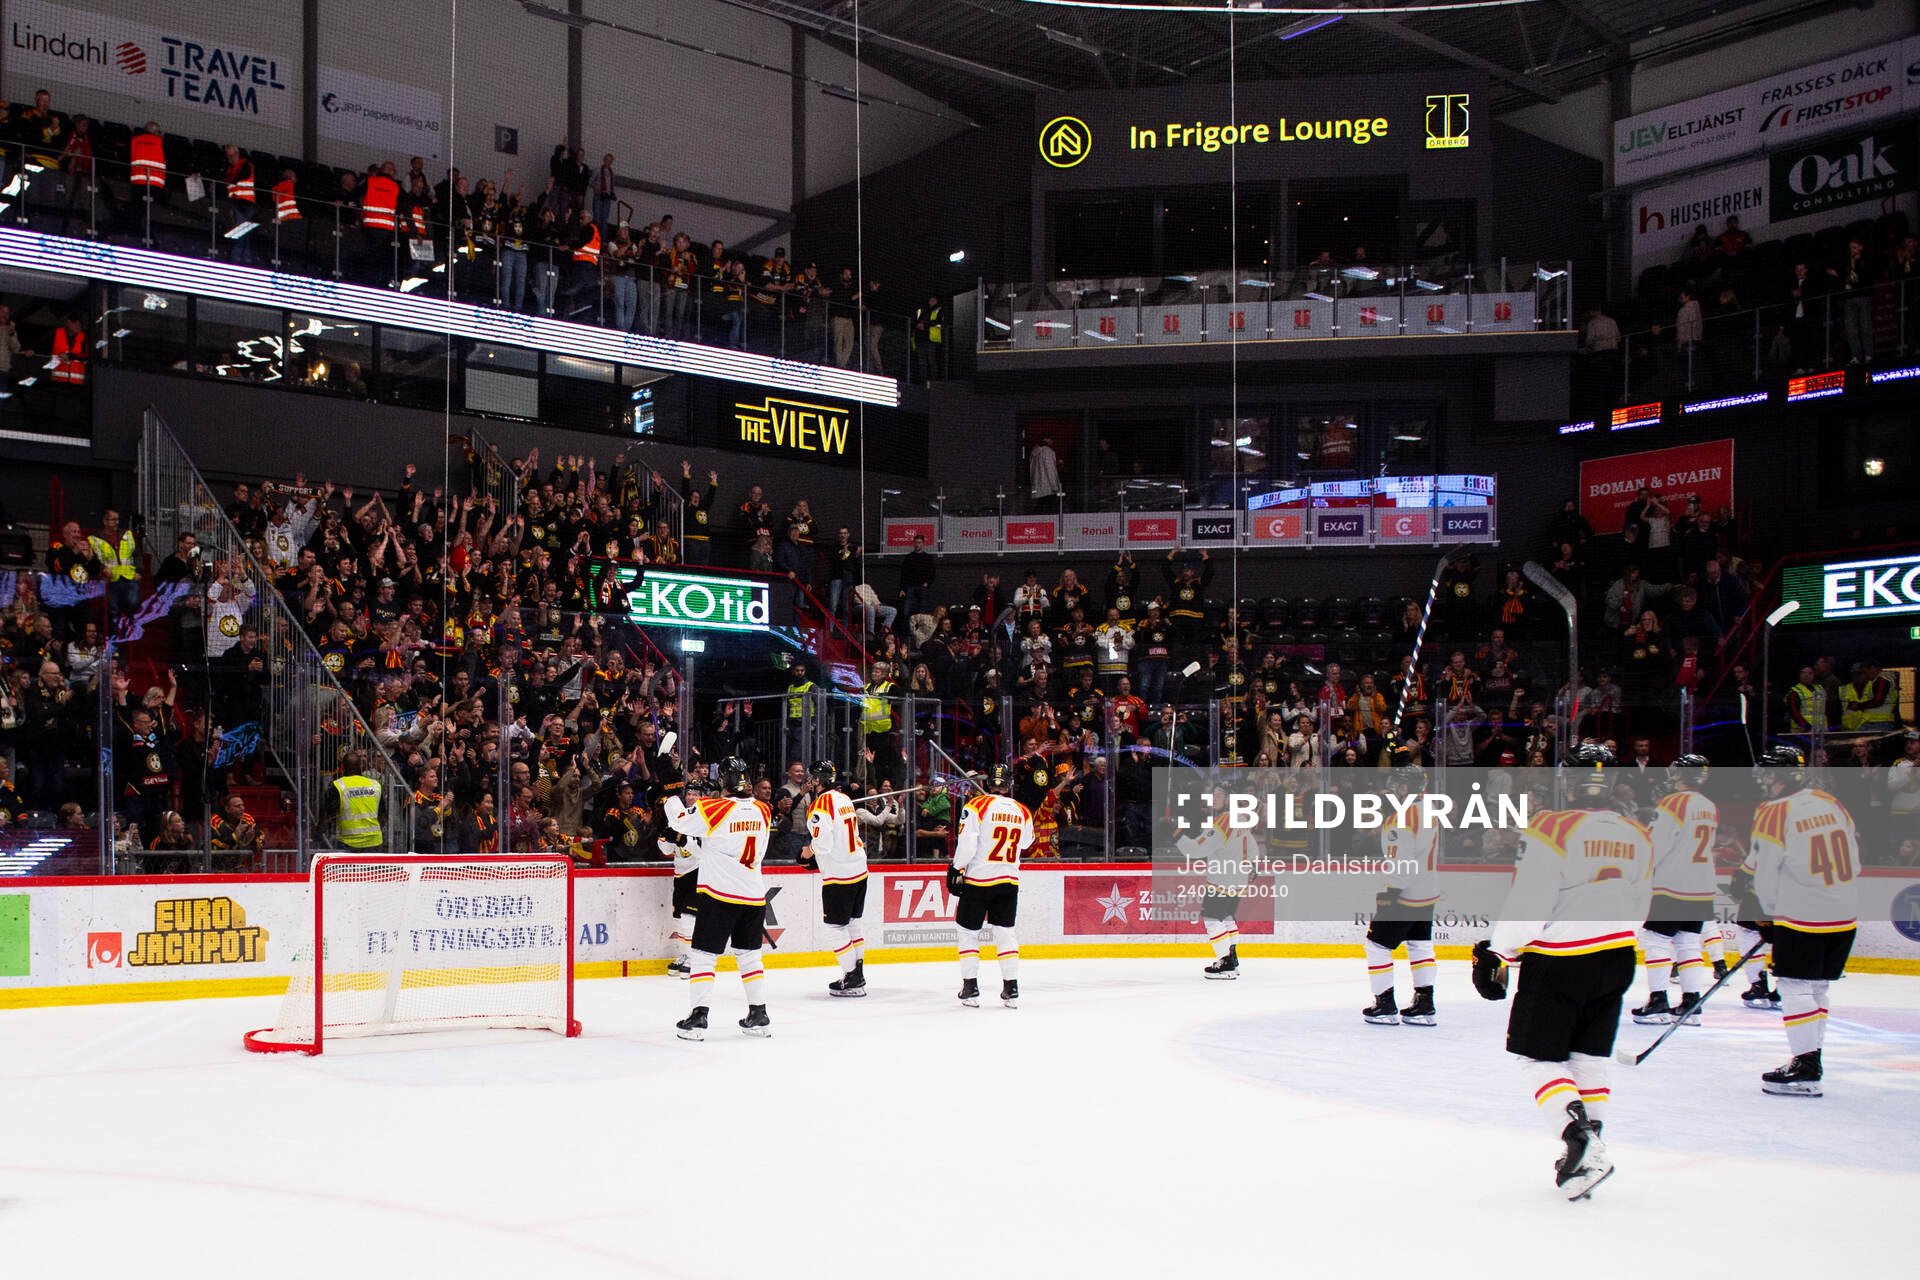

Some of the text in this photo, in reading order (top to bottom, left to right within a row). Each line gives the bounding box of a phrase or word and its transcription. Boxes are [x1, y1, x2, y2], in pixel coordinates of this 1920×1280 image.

[13, 22, 108, 66] Lindahl
[161, 37, 286, 91] TRAVEL
[1761, 73, 1836, 105] FRASSES
[1841, 57, 1888, 83] DÄCK
[161, 68, 259, 115] TEAM
[340, 101, 362, 114] JRP
[424, 121, 440, 132] AB
[1130, 116, 1389, 153] In Frigore Lounge
[1619, 121, 1667, 153] JEV
[1668, 107, 1745, 140] ELTJÄNST
[1788, 135, 1901, 196] Oak
[1671, 187, 1763, 228] HUSHERREN
[1791, 180, 1896, 212] CONSULTING
[735, 407, 850, 455] THE VIEW
[1589, 467, 1723, 497] BOMAN & SVAHN
[1197, 524, 1233, 535] EXACT
[1323, 521, 1358, 532] EXACT
[1447, 519, 1483, 530] EXACT
[624, 580, 769, 624] EKOtid
[739, 835, 757, 870] 4
[988, 826, 1022, 863] 23
[1810, 829, 1853, 886] 40
[155, 897, 237, 933] EURO
[435, 889, 533, 919] ÖREBRO
[1139, 907, 1201, 924] Mining
[128, 927, 264, 967] JACKPOT
[367, 920, 609, 955] FLTTNINGSBYR AB
[908, 931, 921, 941] AIR
[922, 930, 959, 941] MAINTEN
